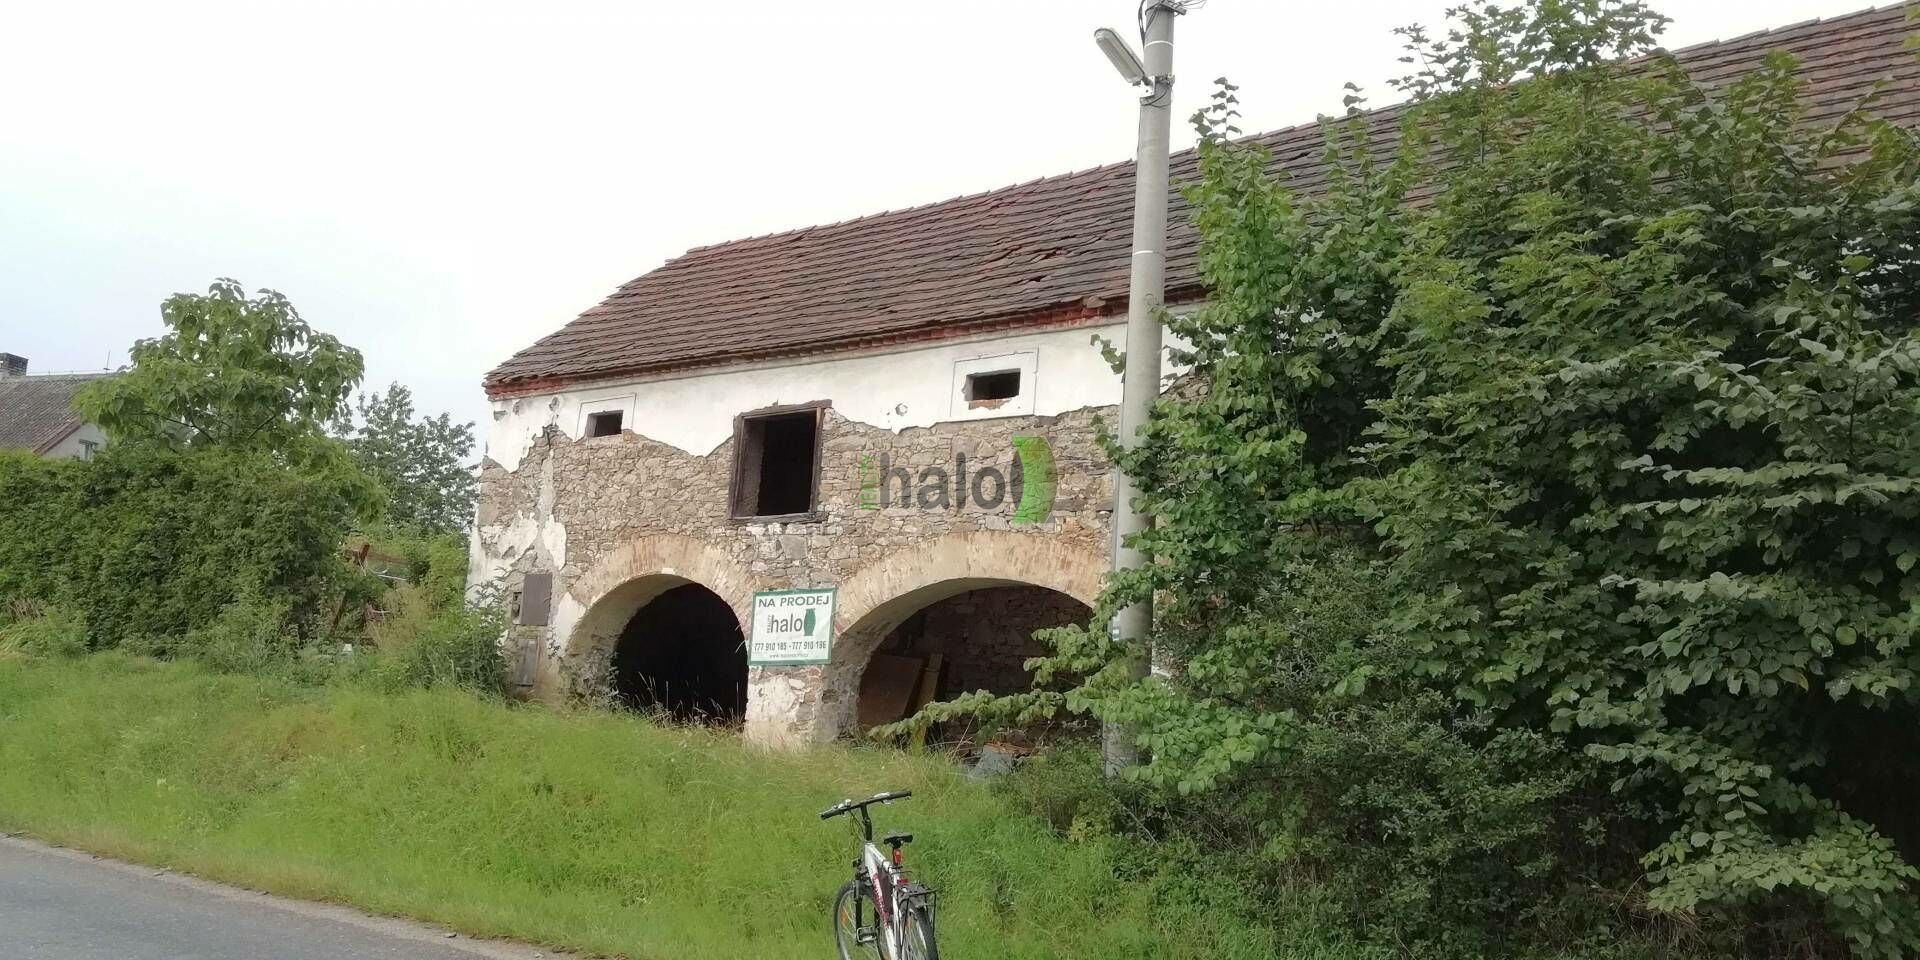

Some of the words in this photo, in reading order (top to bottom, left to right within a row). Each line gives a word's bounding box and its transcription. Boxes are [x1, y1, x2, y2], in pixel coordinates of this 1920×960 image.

[758, 598, 776, 608] NA
[780, 595, 830, 607] PRODEJ
[770, 613, 803, 633] halo
